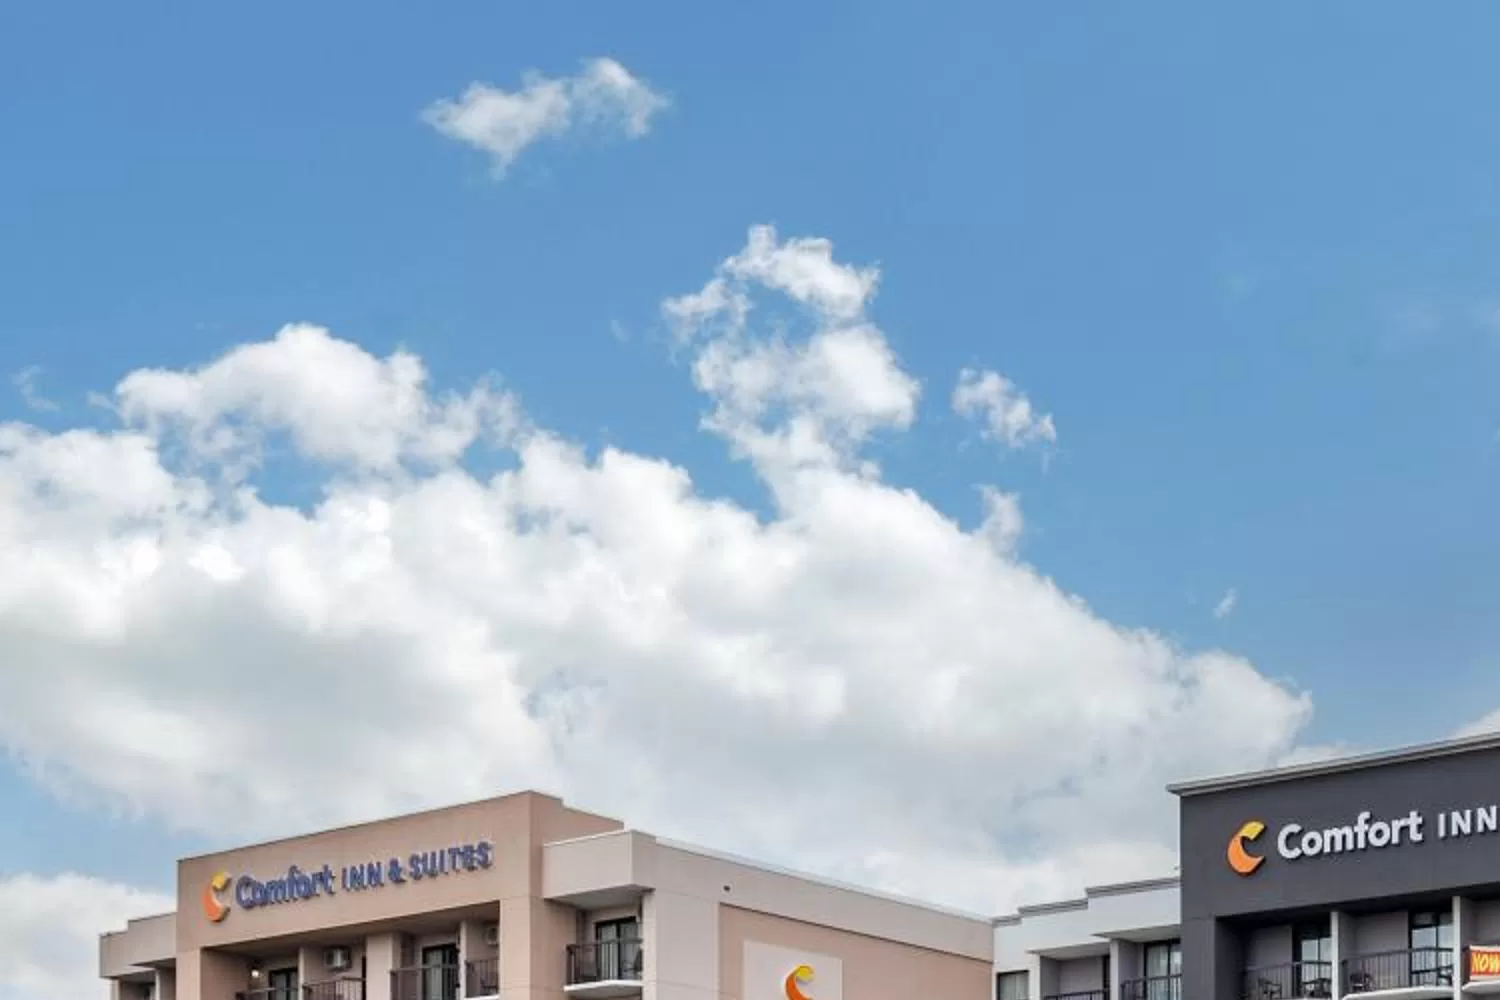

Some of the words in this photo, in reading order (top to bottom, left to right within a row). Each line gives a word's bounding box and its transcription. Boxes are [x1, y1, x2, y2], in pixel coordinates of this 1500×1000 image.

[1277, 810, 1423, 859] Comfort
[1438, 805, 1497, 838] INN
[235, 865, 335, 909] Comfort
[342, 861, 384, 892] INN
[388, 858, 406, 883] &
[409, 841, 494, 880] SUITES
